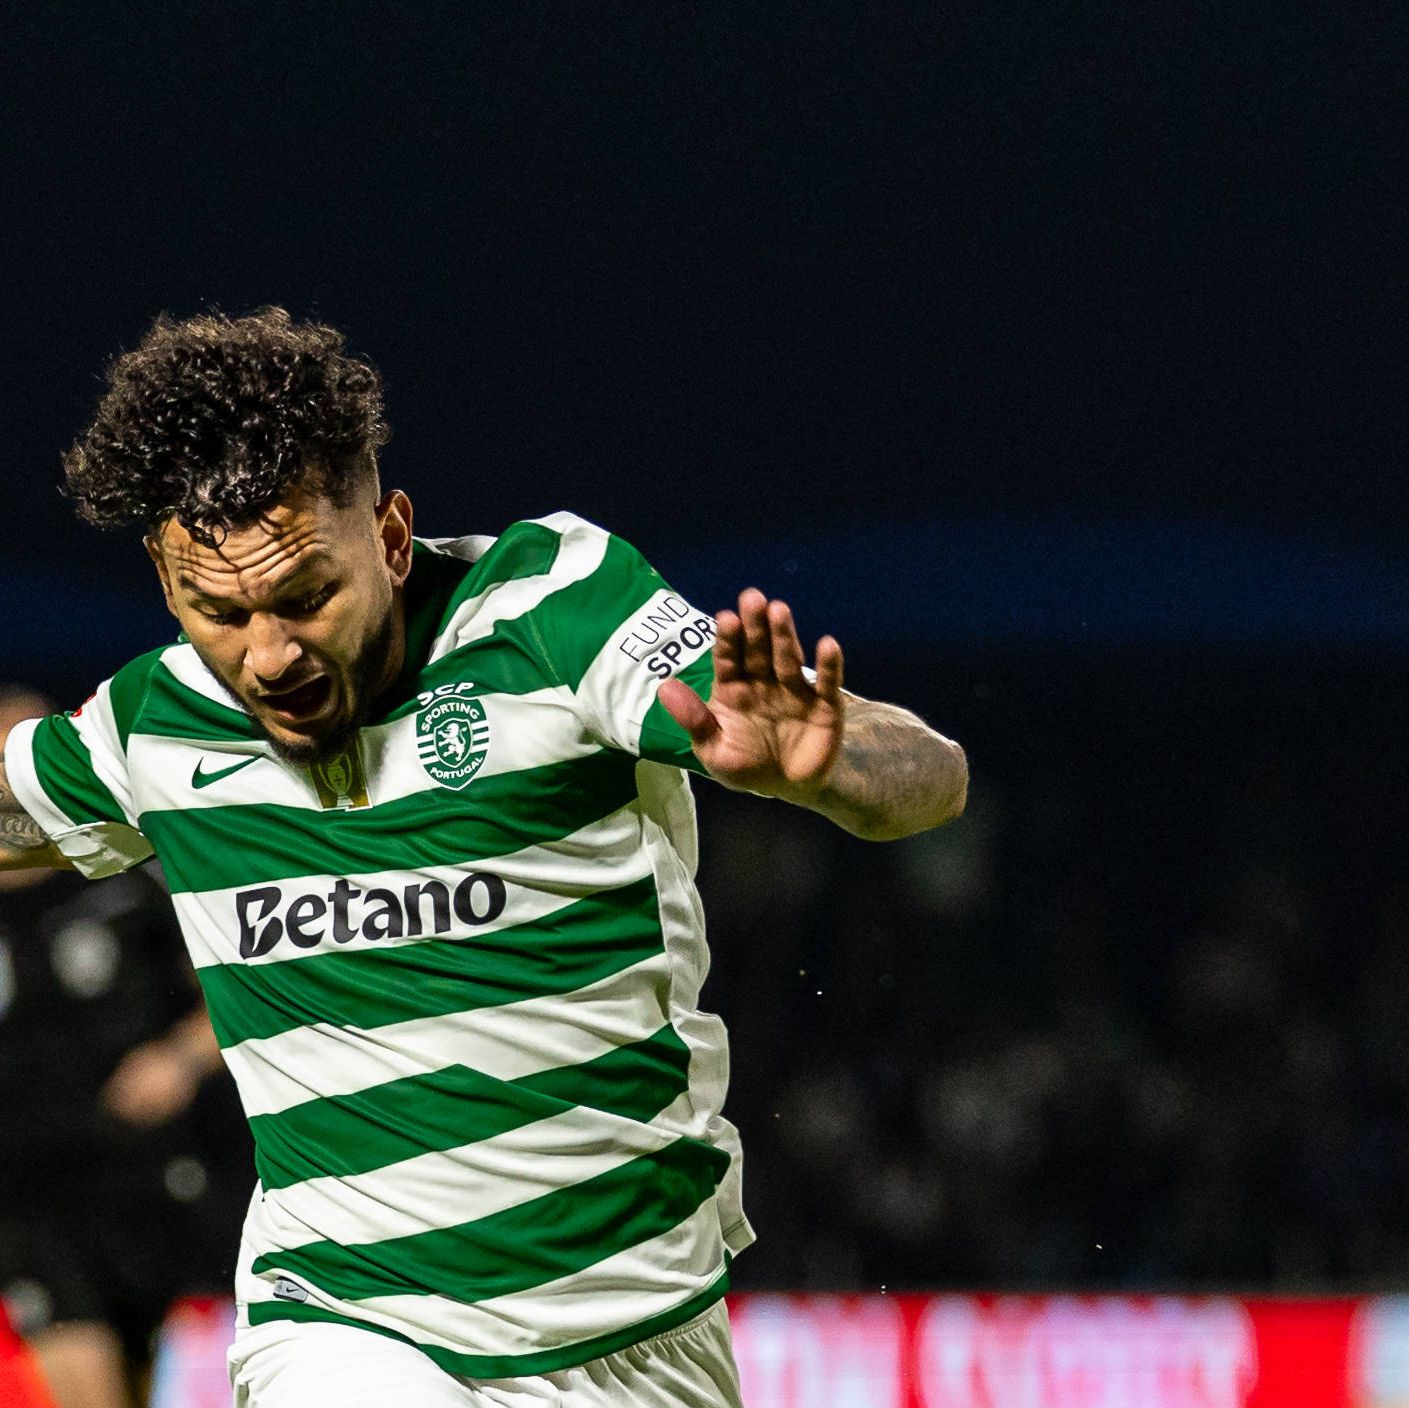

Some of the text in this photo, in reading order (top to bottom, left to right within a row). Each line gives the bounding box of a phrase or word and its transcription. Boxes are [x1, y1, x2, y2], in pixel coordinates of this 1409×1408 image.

[647, 616, 718, 680] SPOR
[417, 682, 474, 706] SCP
[420, 702, 480, 733] SPORTING
[430, 756, 483, 779] PORTUGAL
[235, 872, 507, 960] Betano
